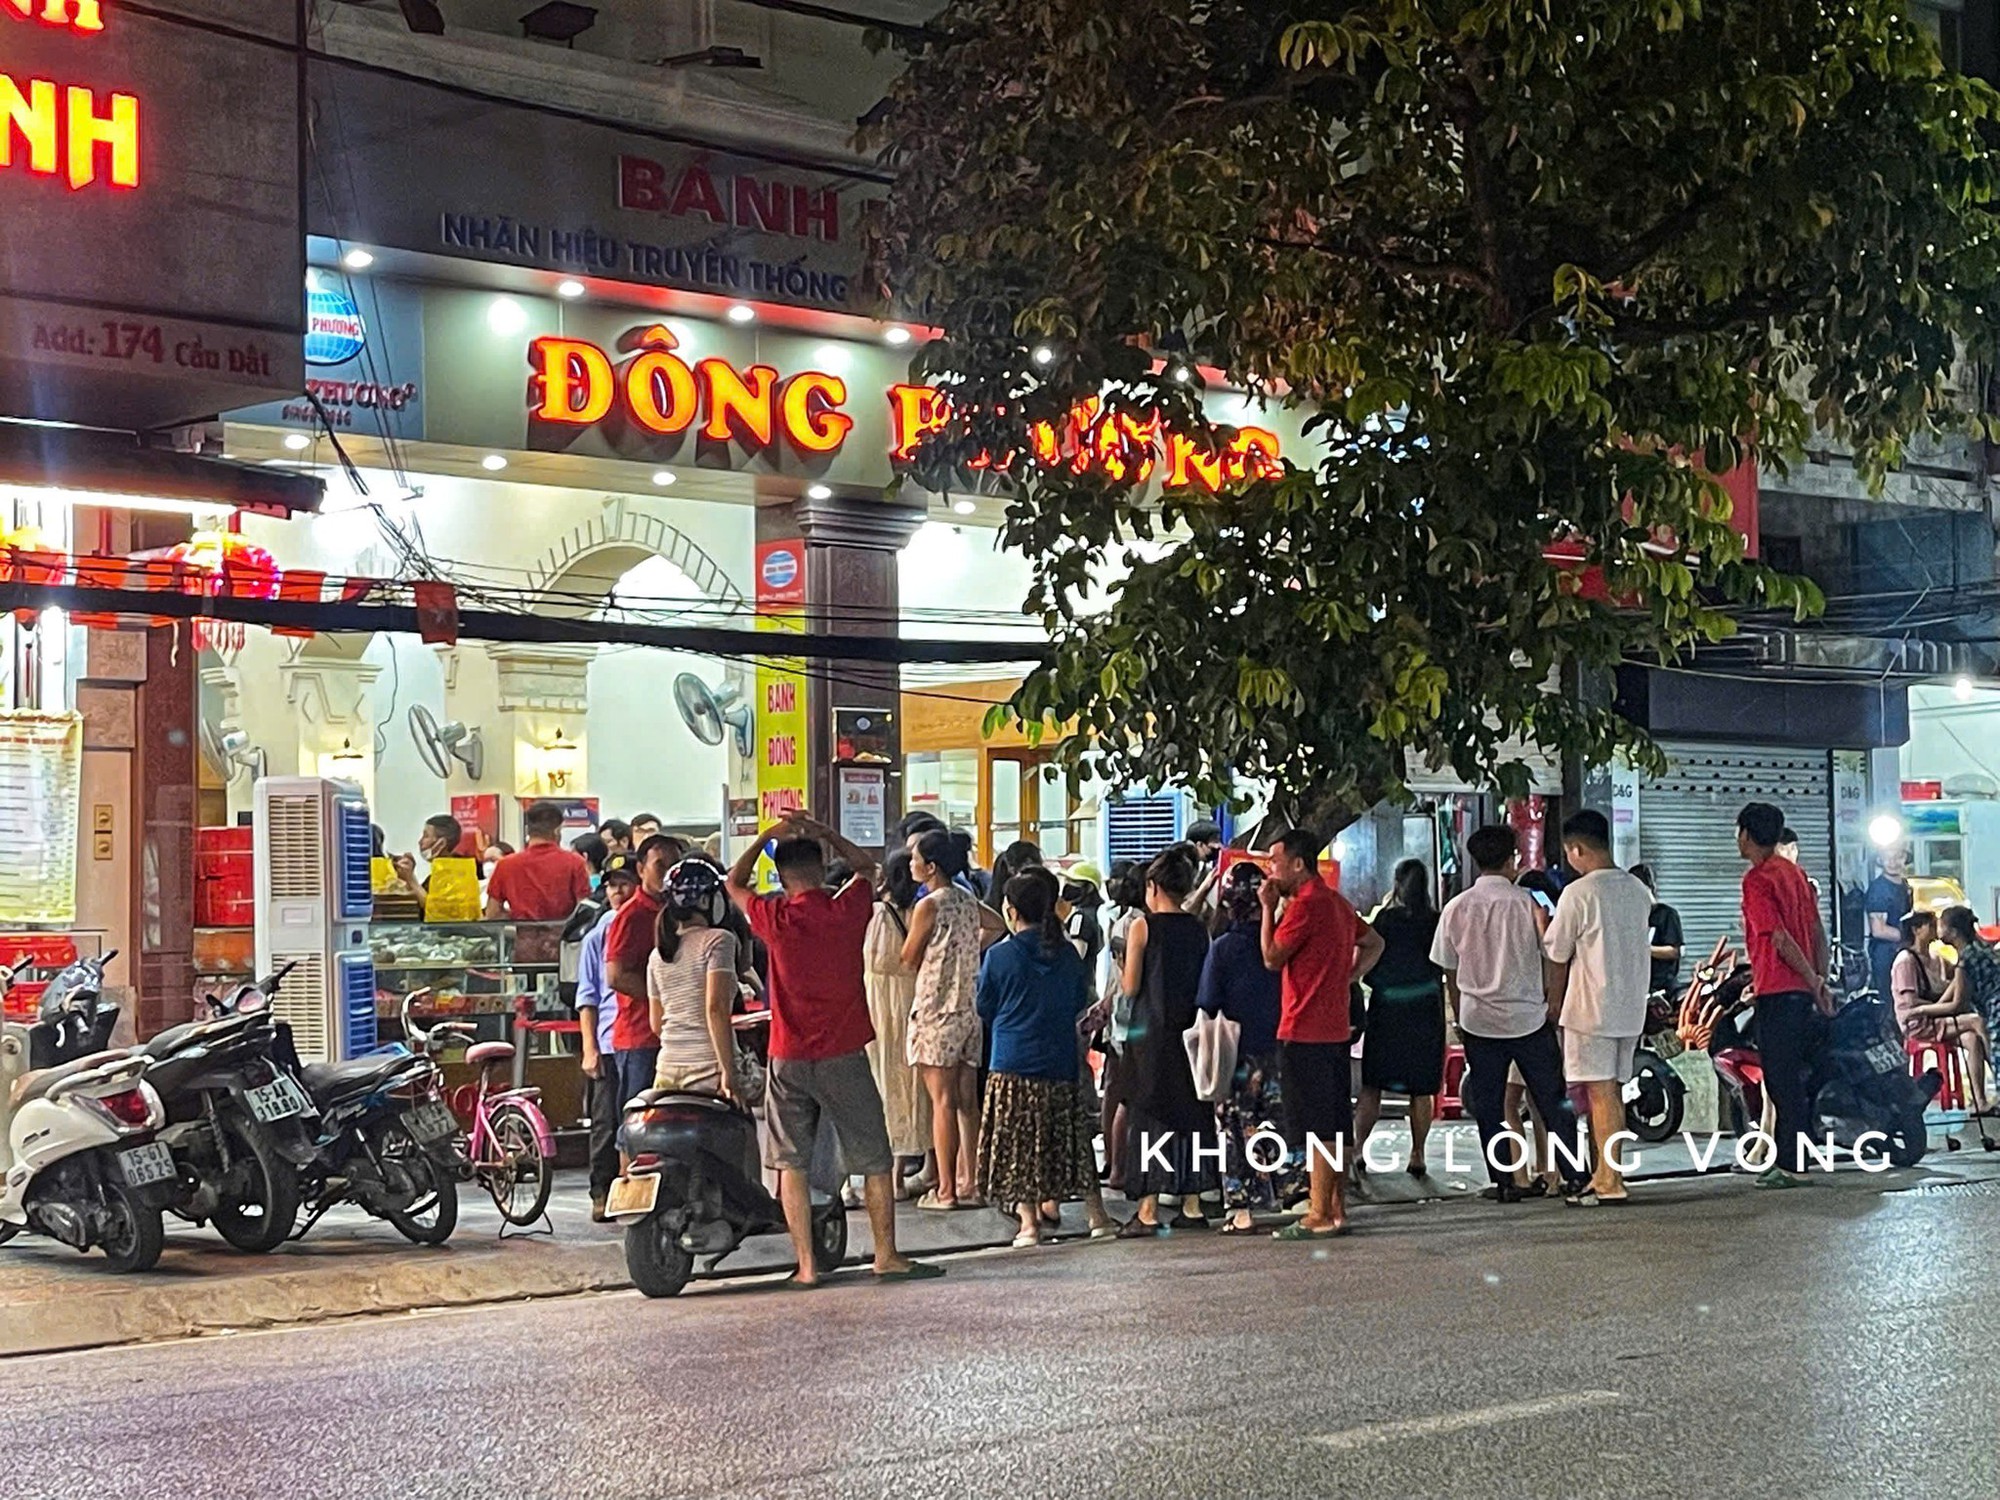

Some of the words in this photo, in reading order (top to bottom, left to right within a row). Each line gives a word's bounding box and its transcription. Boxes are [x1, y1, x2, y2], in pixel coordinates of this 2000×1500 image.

[618, 151, 838, 241] BÁNH
[440, 211, 539, 258] NHÃN
[549, 228, 619, 273] HIỆU
[627, 240, 740, 288] TRUYỀN
[749, 254, 848, 301] THỐNG
[101, 322, 165, 363] 174
[530, 323, 853, 451] ĐÔNG
